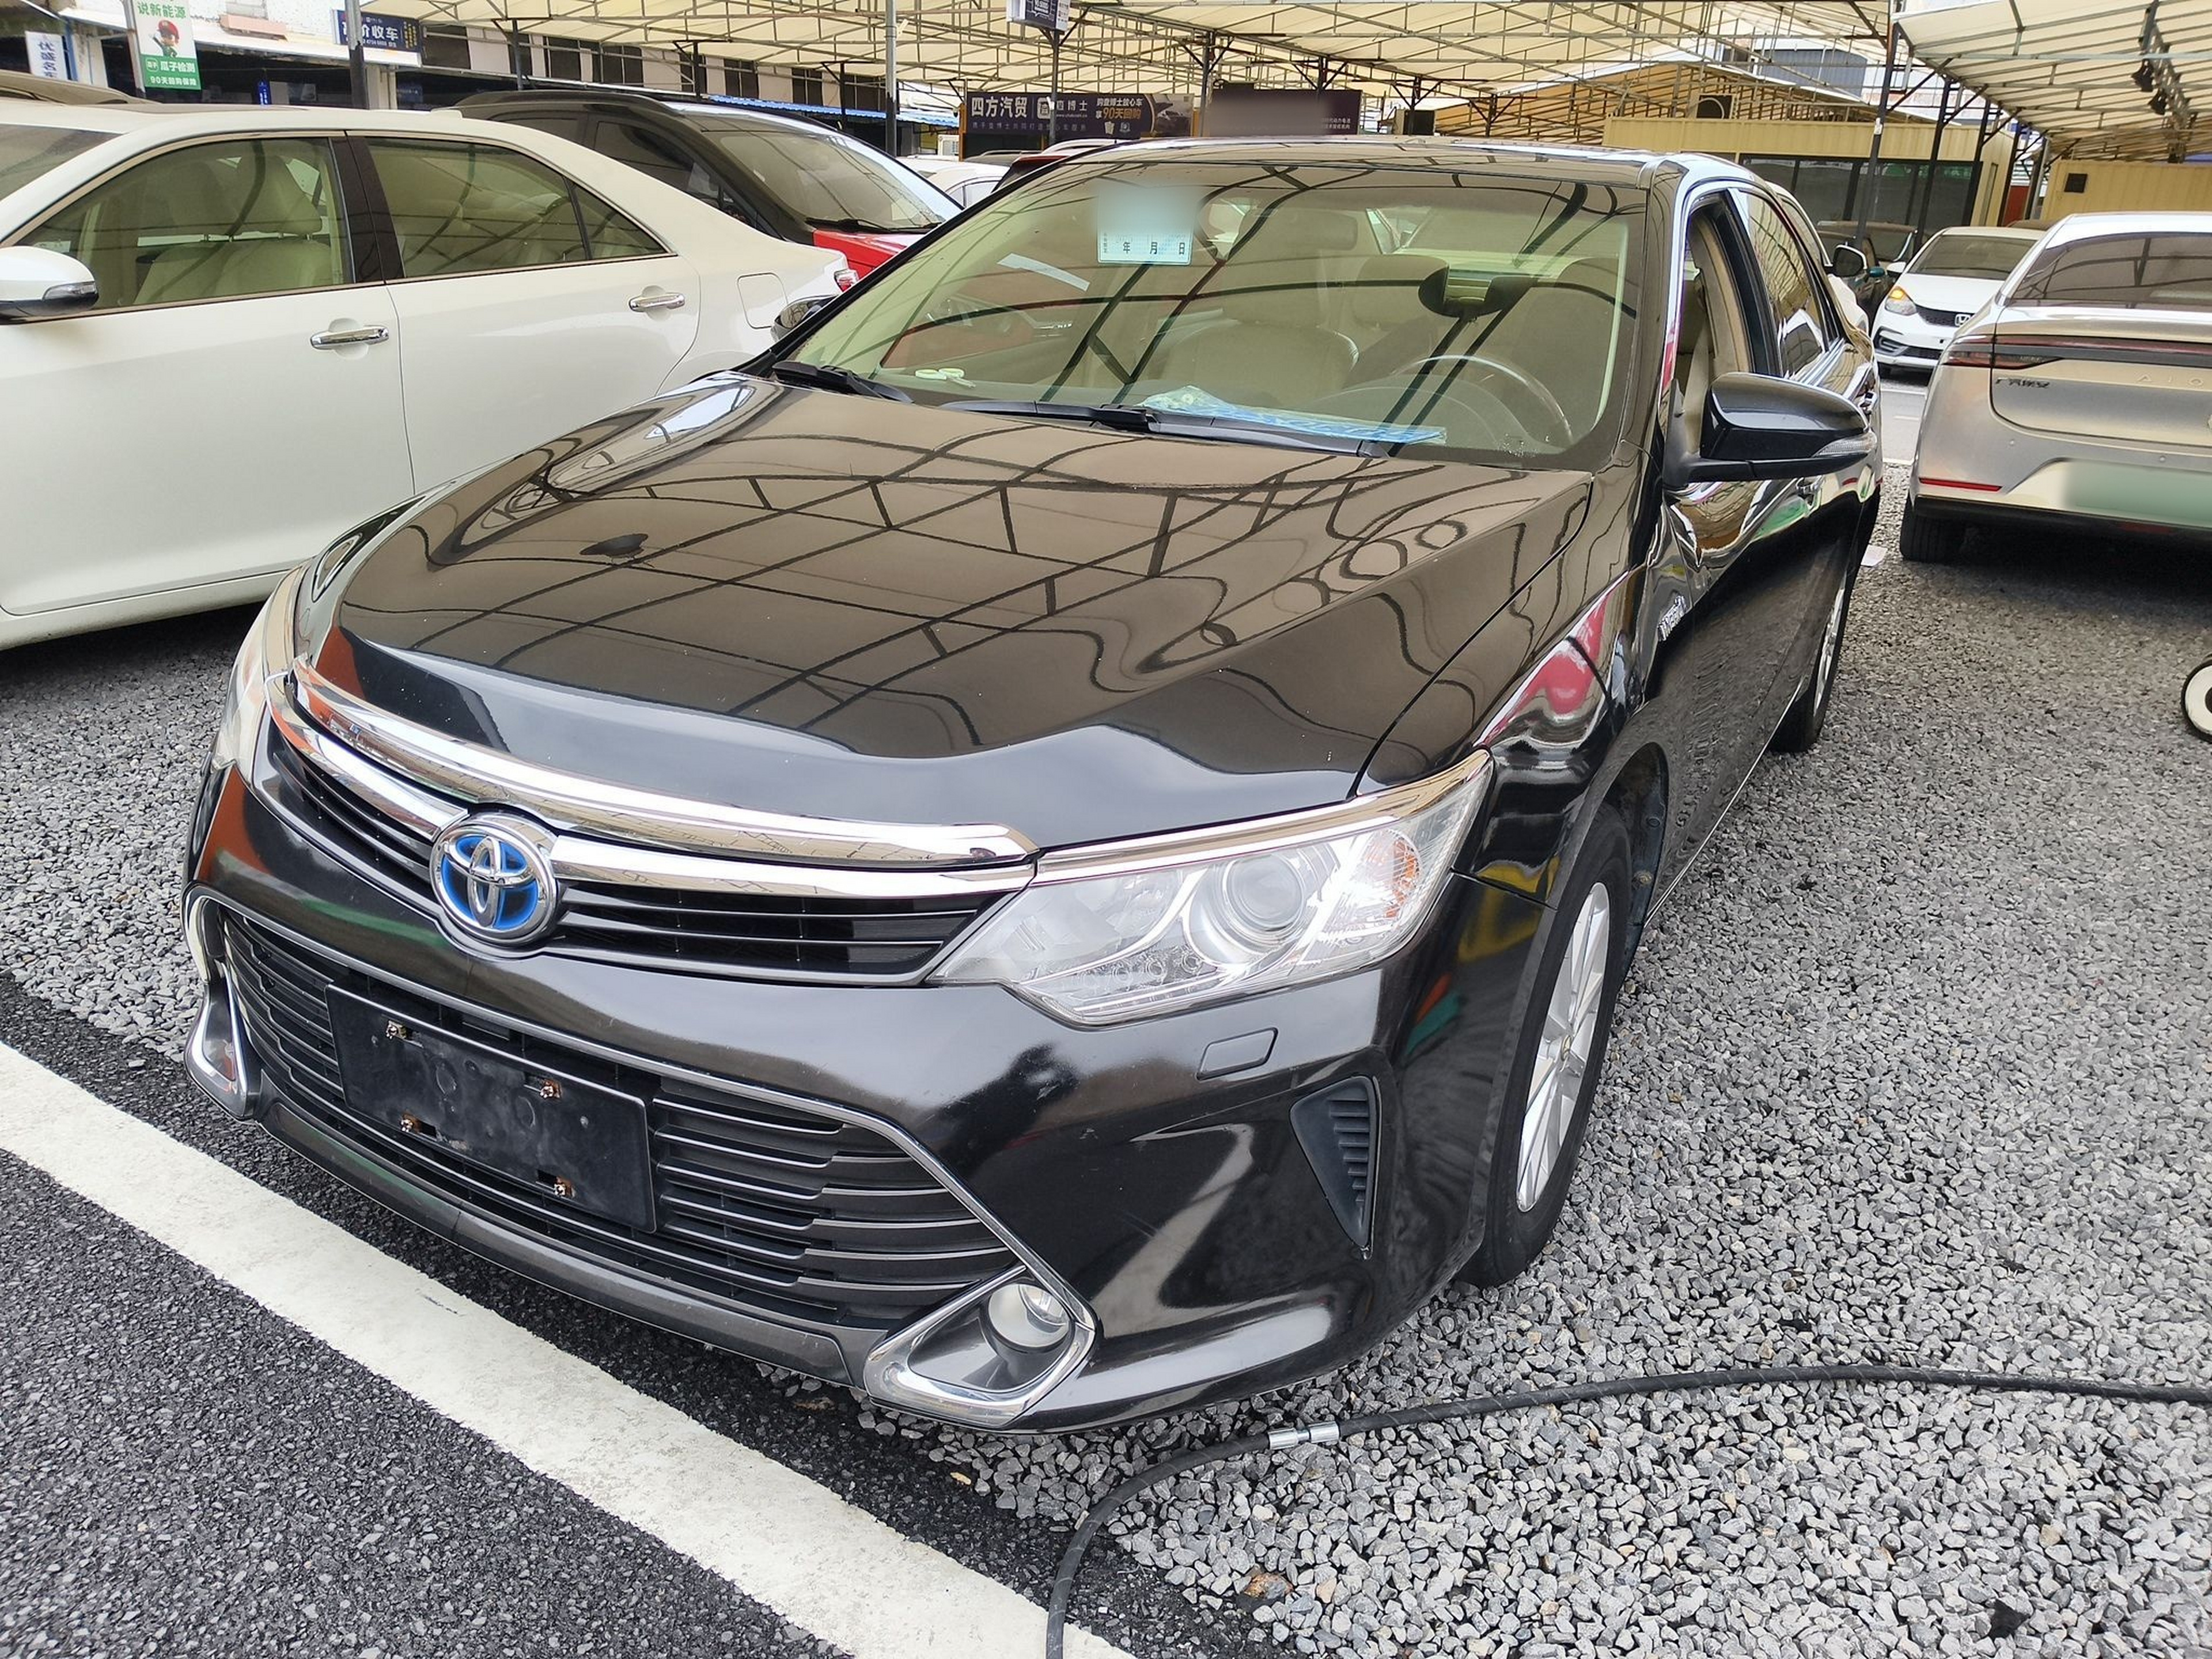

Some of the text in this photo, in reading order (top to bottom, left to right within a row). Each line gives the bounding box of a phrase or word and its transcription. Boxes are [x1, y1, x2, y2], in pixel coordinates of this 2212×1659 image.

[138, 2, 186, 18] 说新能源
[160, 60, 195, 73] 瓜子检测
[971, 96, 1028, 118] 四方汽贸
[1123, 241, 1185, 255] 年 月 日
